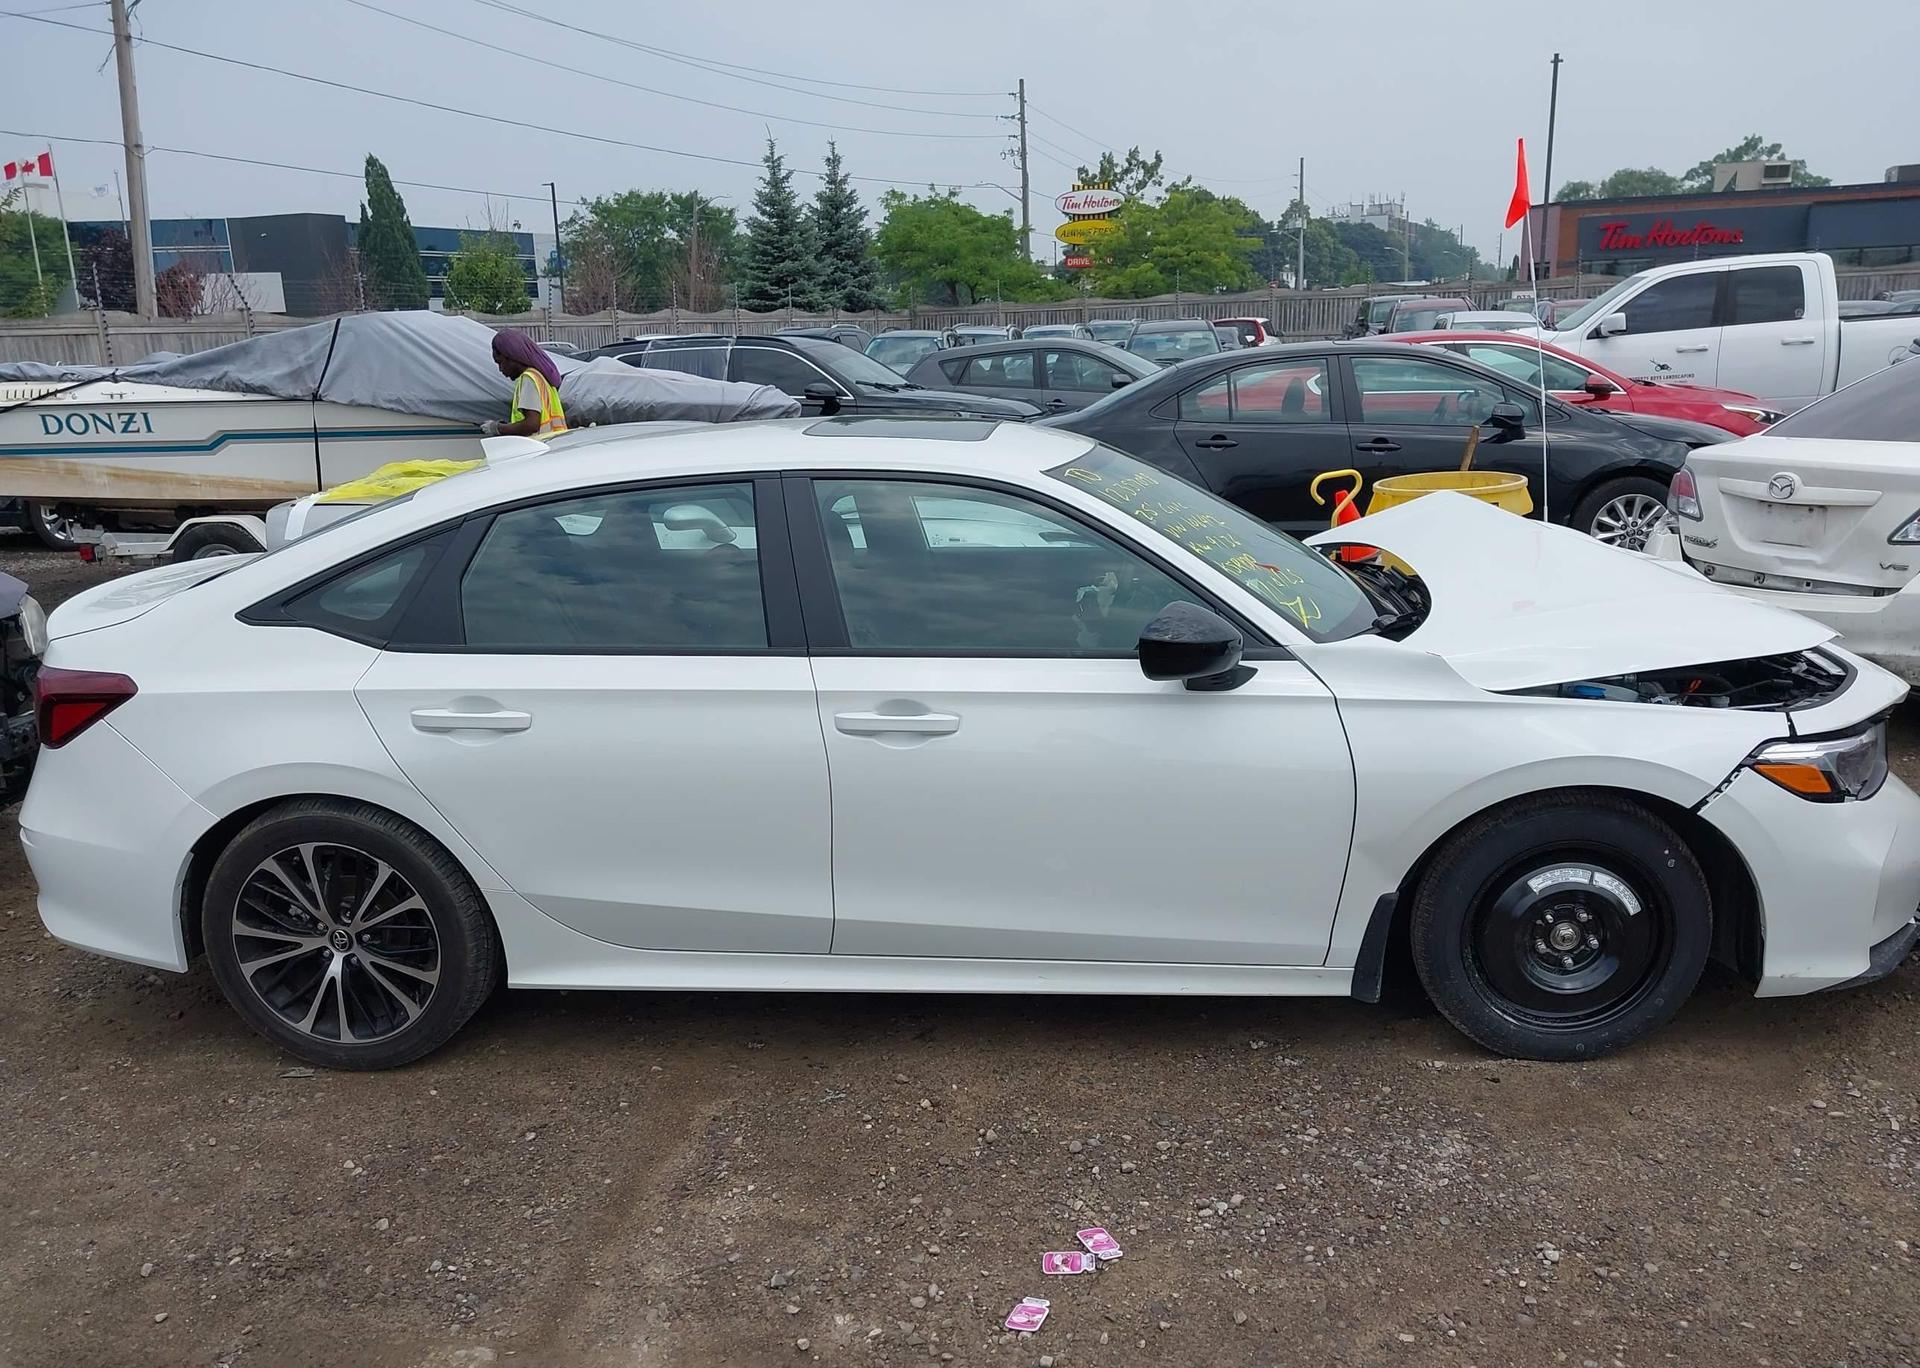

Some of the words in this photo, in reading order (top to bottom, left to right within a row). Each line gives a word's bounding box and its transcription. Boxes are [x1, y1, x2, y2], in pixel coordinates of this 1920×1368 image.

[1061, 195, 1081, 210] Tim
[1599, 221, 1642, 250] Tim
[1645, 218, 1744, 248] Hortons
[1067, 257, 1090, 266] DRIVE
[39, 411, 155, 436] DONZI
